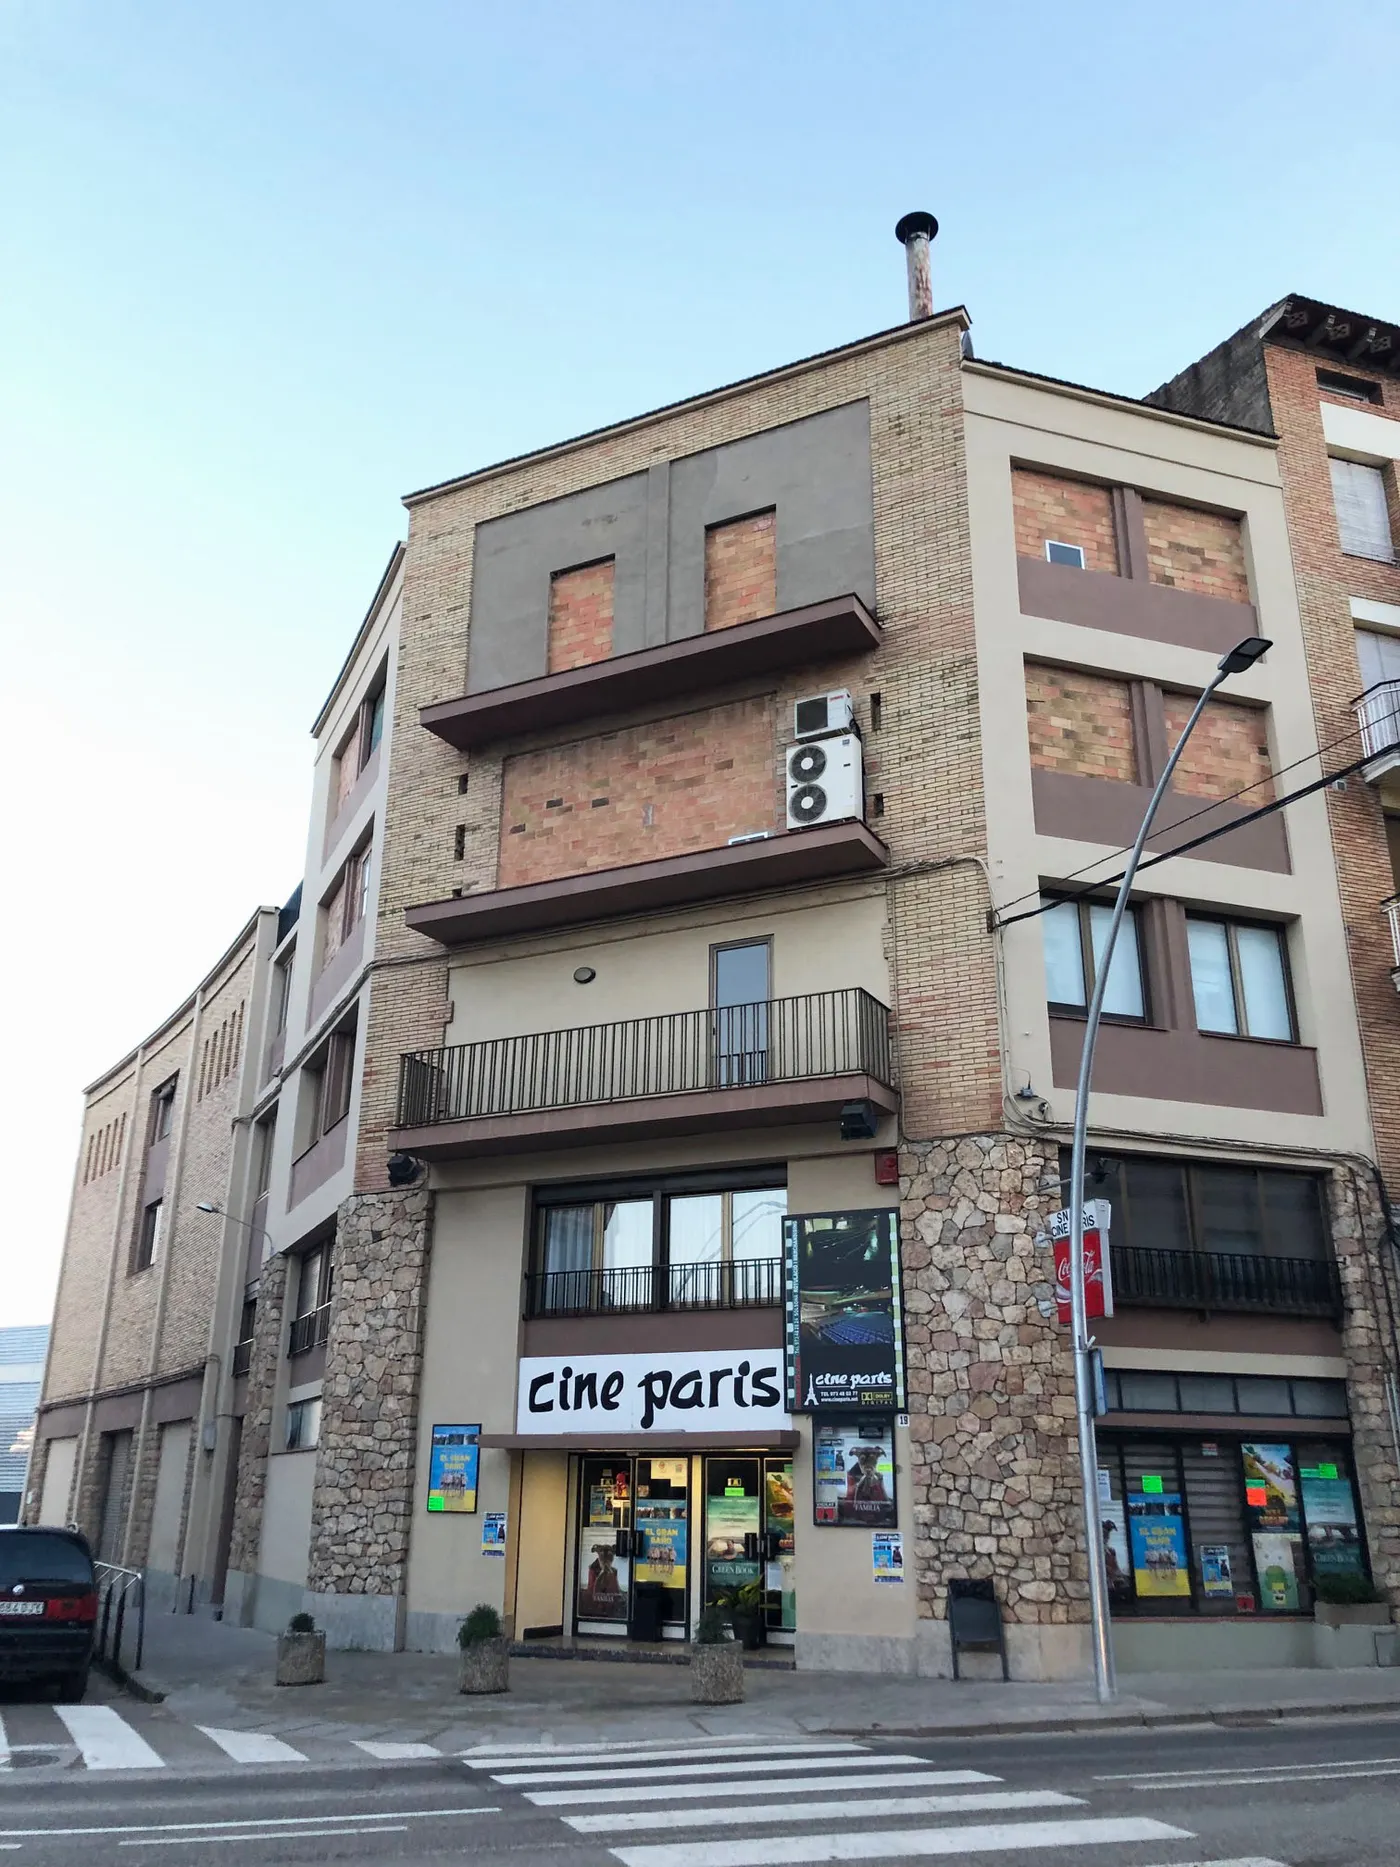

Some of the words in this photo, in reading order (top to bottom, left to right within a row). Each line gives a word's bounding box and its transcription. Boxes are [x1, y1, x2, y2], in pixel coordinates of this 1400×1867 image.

[1052, 1222, 1069, 1236] CINE
[815, 1373, 848, 1385] cine
[850, 1371, 892, 1389] paris
[529, 1366, 624, 1413] cine
[637, 1360, 780, 1429] paris
[900, 1416, 908, 1425] 19
[645, 1528, 654, 1536] EL
[656, 1528, 678, 1536] GRAN
